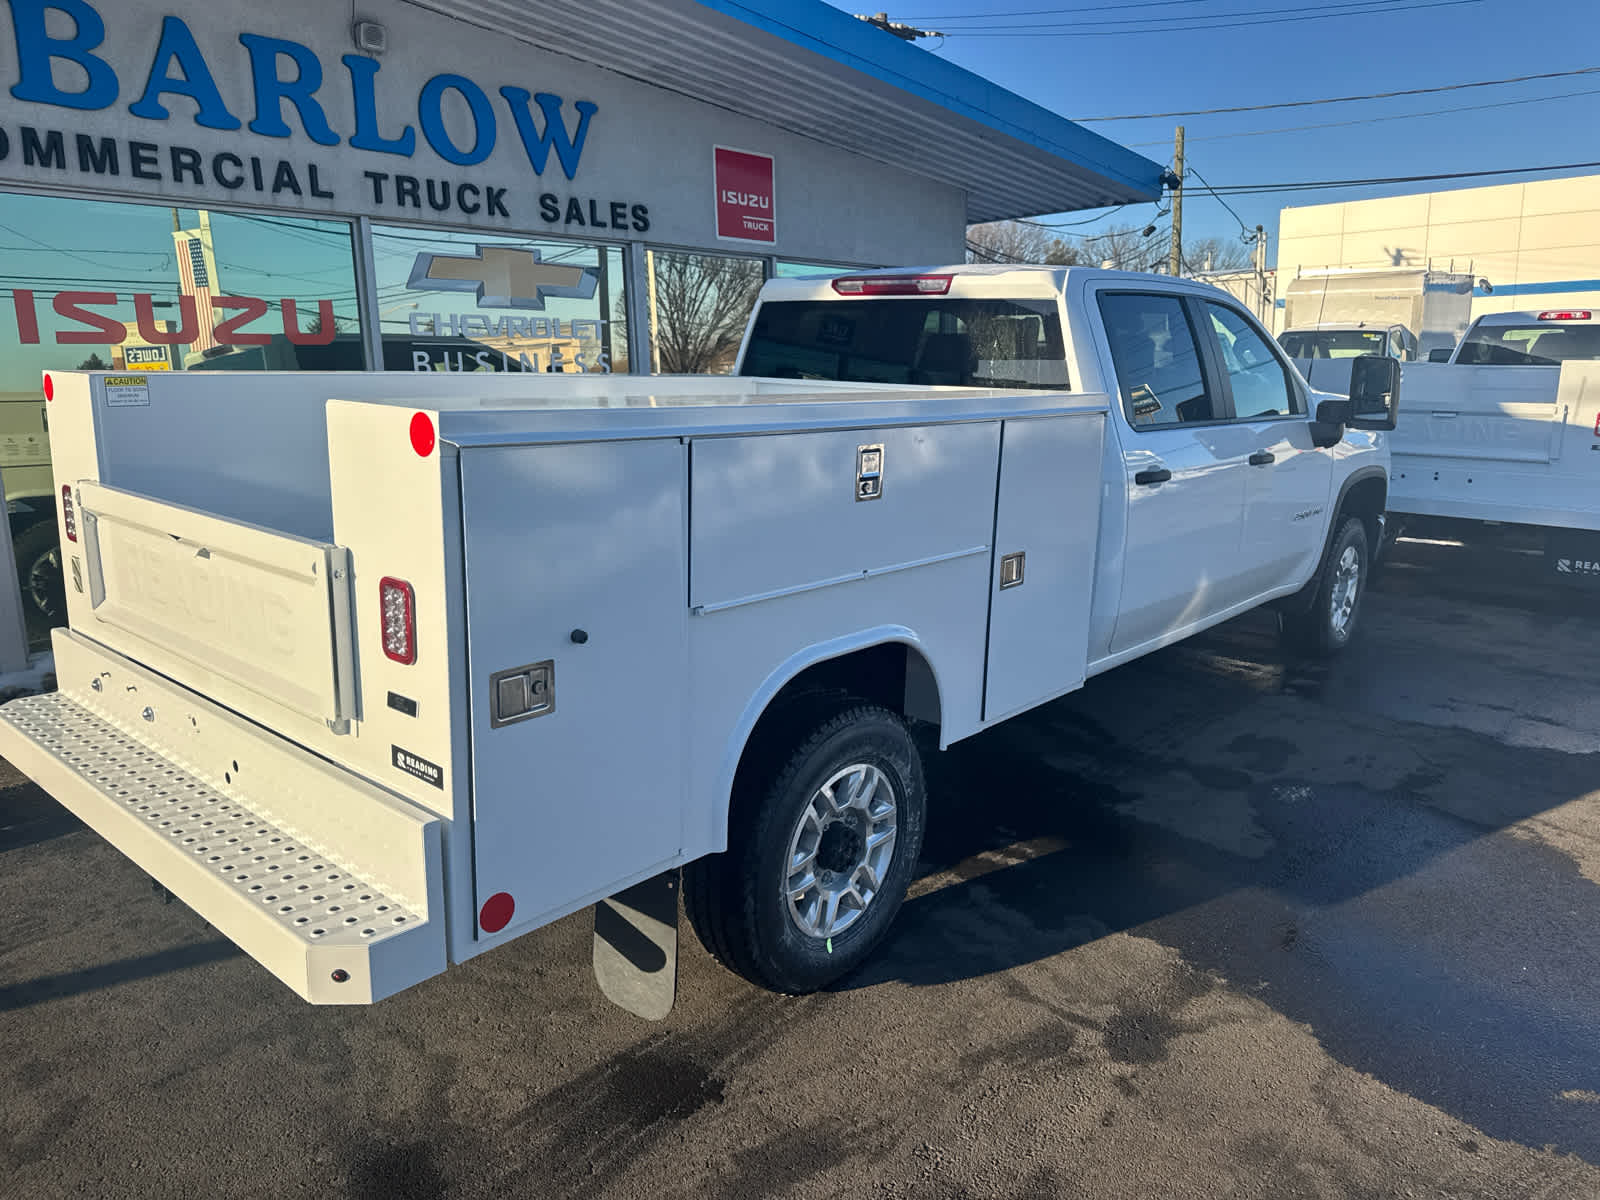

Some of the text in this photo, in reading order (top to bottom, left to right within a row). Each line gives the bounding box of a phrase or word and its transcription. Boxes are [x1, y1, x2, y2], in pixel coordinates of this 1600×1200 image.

[8, 0, 599, 181] BARLOW
[0, 126, 651, 232] MMERCIAL TRUCK SALES
[722, 189, 769, 209] ISUZU
[743, 221, 769, 231] TRUCK
[13, 289, 336, 345] ISUZU
[408, 312, 608, 340] CHEVROLET
[411, 351, 611, 374] BUSINESS
[406, 755, 438, 778] READING
